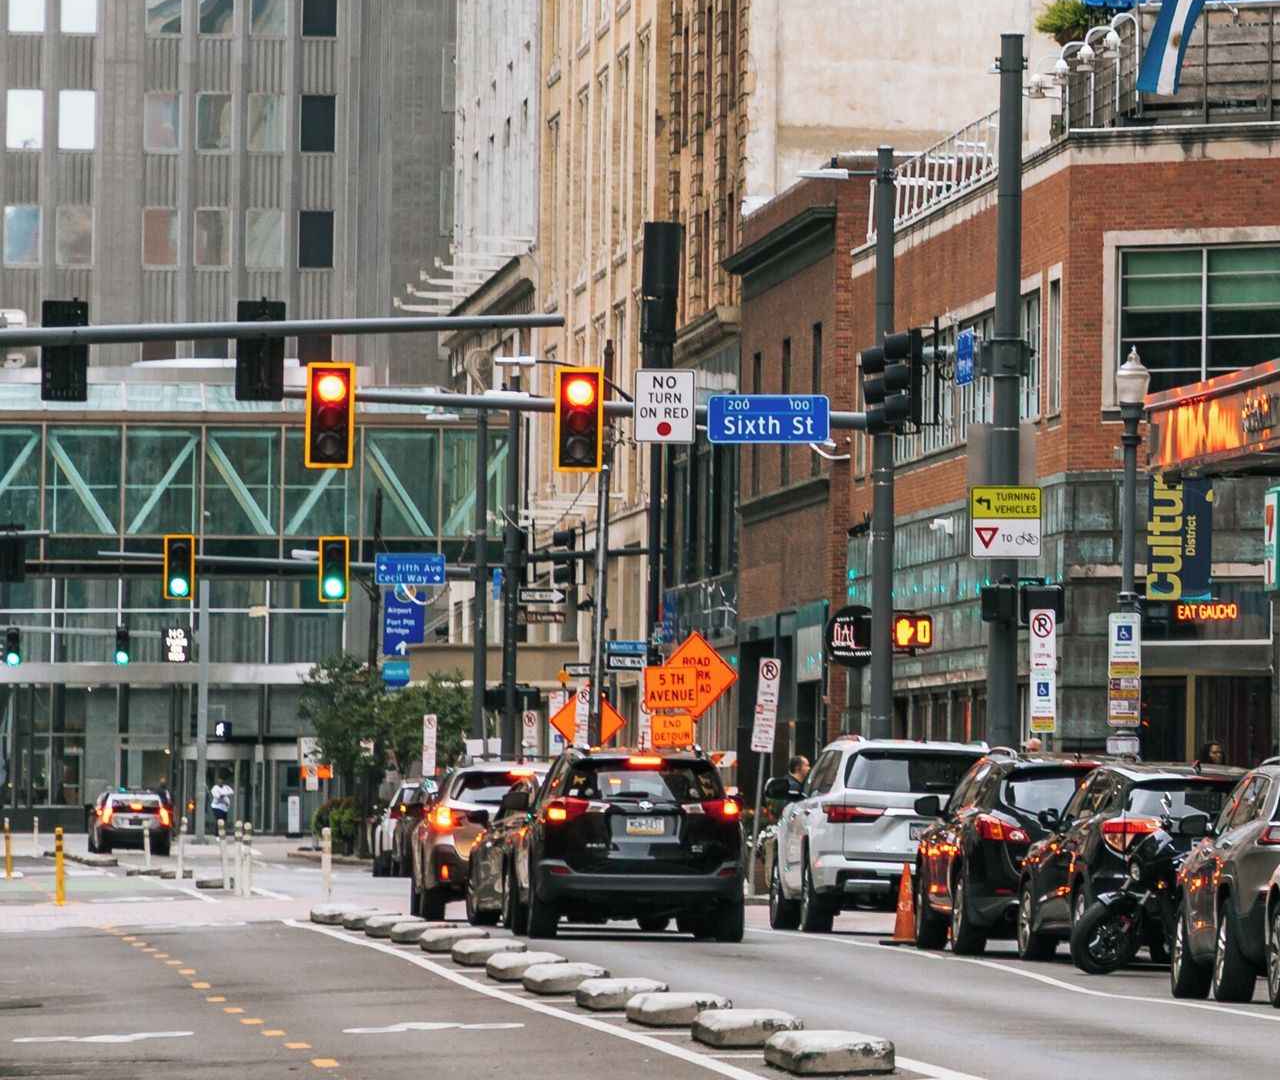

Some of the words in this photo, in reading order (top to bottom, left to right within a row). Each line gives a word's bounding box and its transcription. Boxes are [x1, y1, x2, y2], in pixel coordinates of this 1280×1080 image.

[652, 375, 677, 389] NO
[648, 392, 682, 404] TURN
[728, 400, 750, 411] 200
[790, 400, 810, 411] 100
[640, 407, 657, 419] ON
[664, 407, 689, 419] RED
[723, 415, 781, 435] Sixth
[792, 416, 814, 435] St
[995, 492, 1037, 502] TURNING
[994, 505, 1037, 514] VEHICLES
[1001, 534, 1013, 542] TO
[1185, 514, 1197, 557] District
[397, 563, 420, 572] Fifth
[423, 563, 442, 572] Ave
[378, 573, 403, 583] Cecil
[407, 573, 428, 585] Way
[387, 607, 412, 615] Airport
[1177, 604, 1197, 620] EAT
[1198, 603, 1237, 620] GAUCHO
[168, 628, 185, 639] NO
[682, 657, 711, 666] ROAD
[659, 673, 667, 685] 5
[670, 673, 685, 685] TH
[649, 689, 695, 703] AVENUE
[663, 720, 682, 728] END
[654, 732, 690, 740] DETOUR
